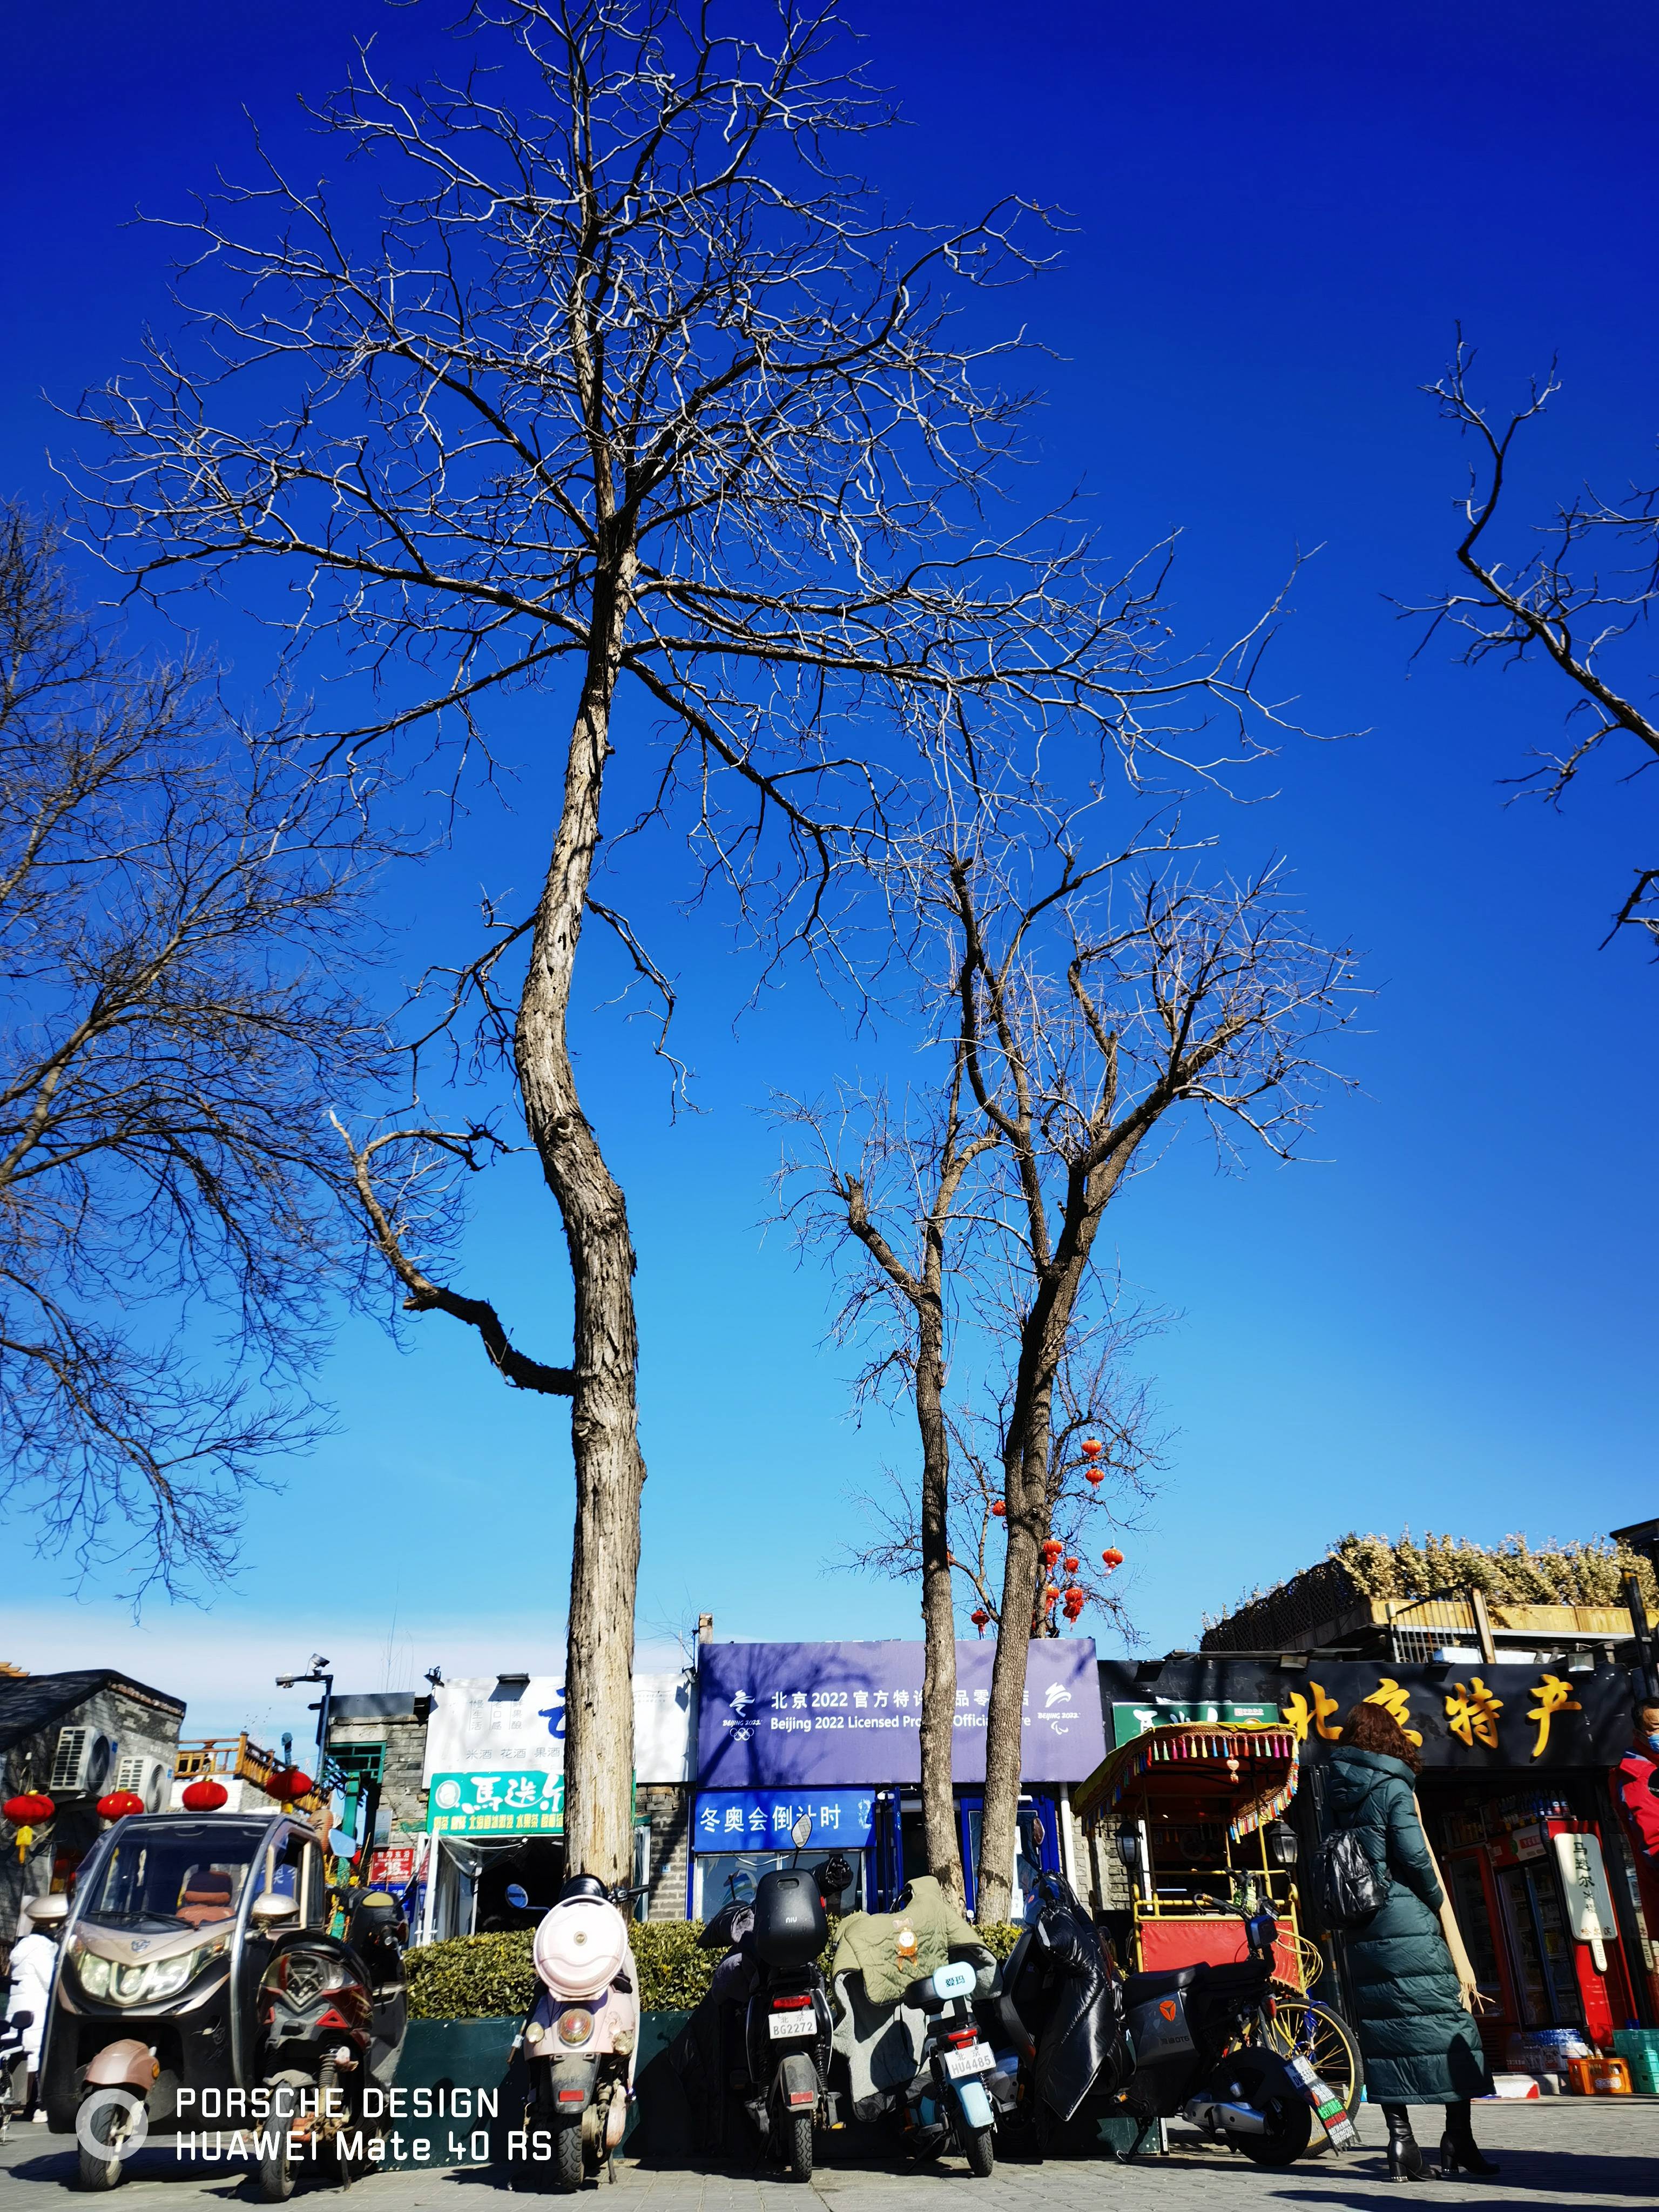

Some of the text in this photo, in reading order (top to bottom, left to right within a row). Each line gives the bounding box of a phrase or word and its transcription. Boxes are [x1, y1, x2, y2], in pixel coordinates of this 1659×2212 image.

[771, 1717, 811, 1732] Beijing
[815, 1716, 844, 1729] 2022
[848, 1715, 899, 1728] Licensed
[466, 1747, 560, 1759] 米酒 花酒 果酒
[946, 1975, 965, 1987] 爱玛
[780, 2014, 804, 2024] 北京
[773, 2022, 813, 2035] BG2272
[956, 2051, 980, 2061] 北京
[951, 2055, 991, 2075] HU4485
